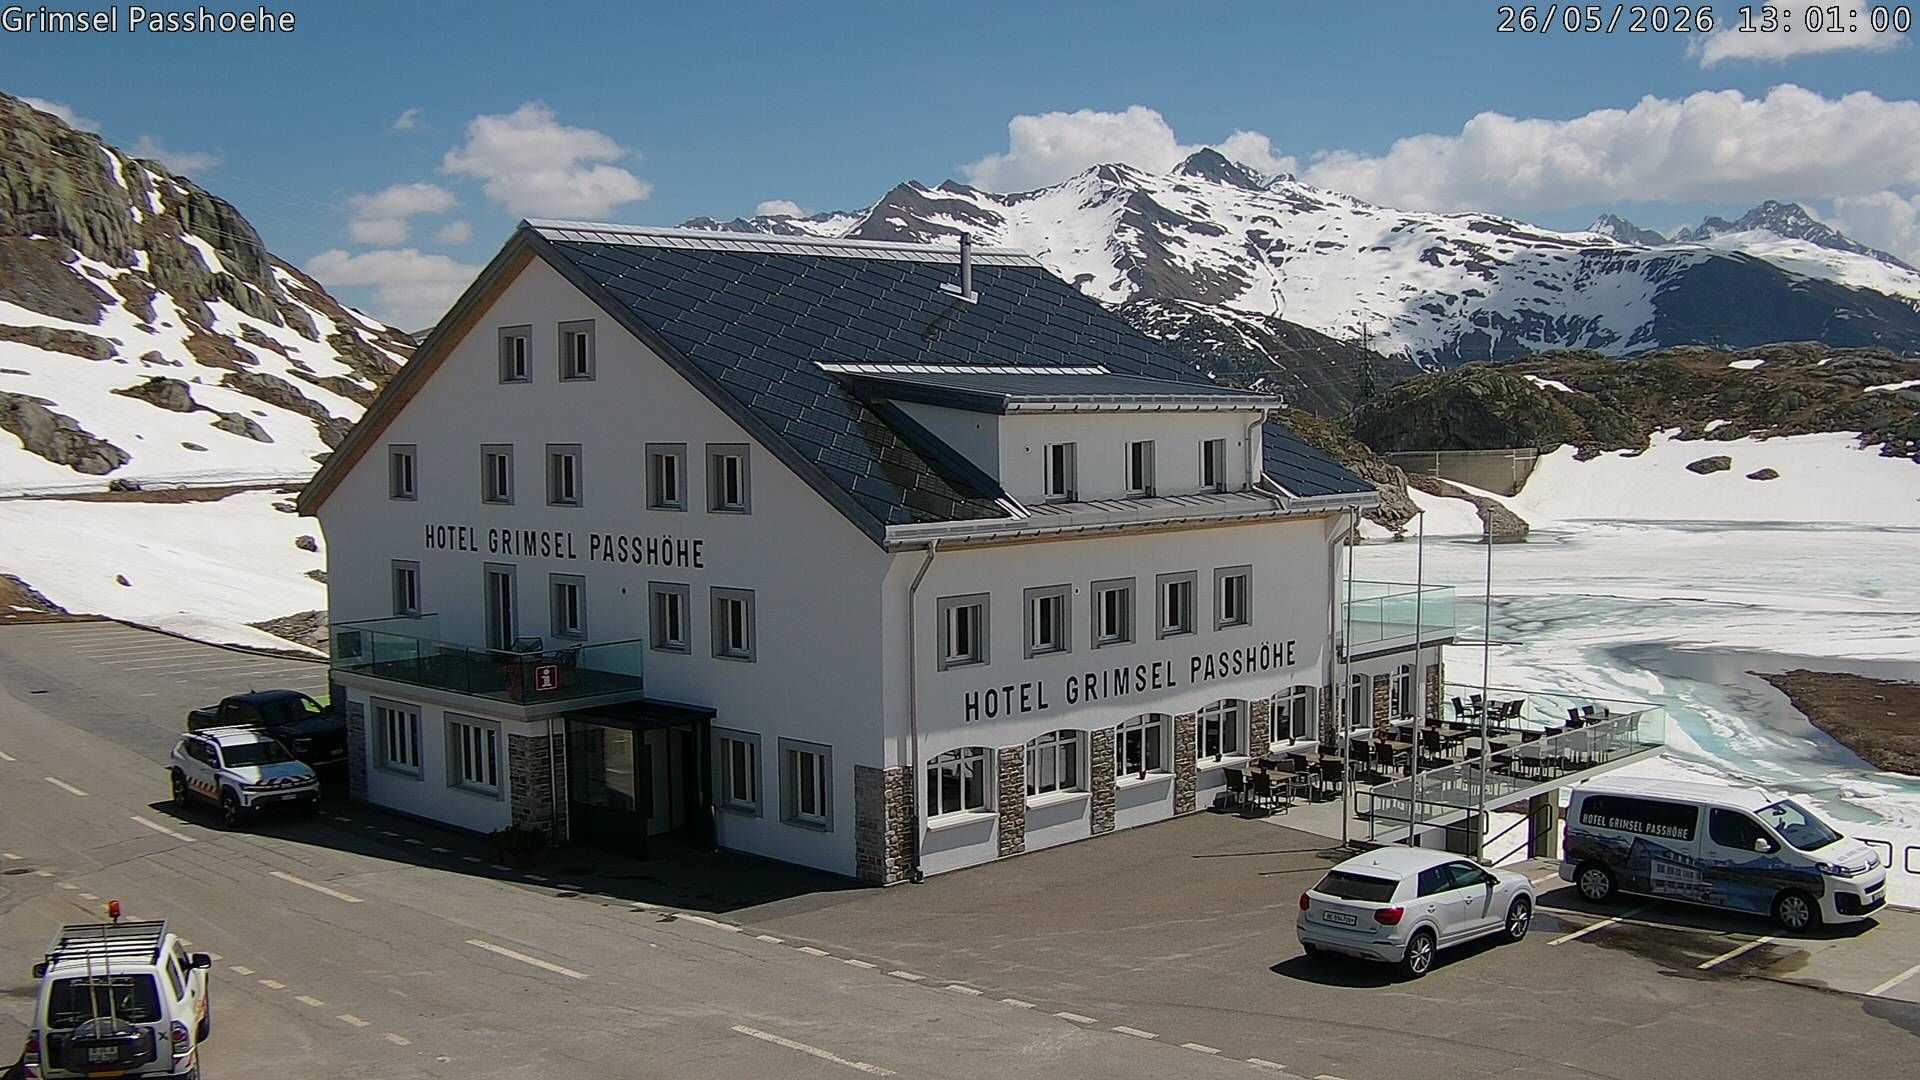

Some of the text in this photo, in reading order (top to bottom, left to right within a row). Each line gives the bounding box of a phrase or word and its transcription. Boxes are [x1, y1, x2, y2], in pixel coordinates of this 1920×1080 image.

[425, 524, 704, 569] HOTEL GRIMSEL PASSHÖHE
[964, 640, 1296, 722] HOTEL GRIMSEL PASSHÖHE
[1582, 813, 1606, 826] HOTEL
[1609, 817, 1643, 832] GRIMSEL
